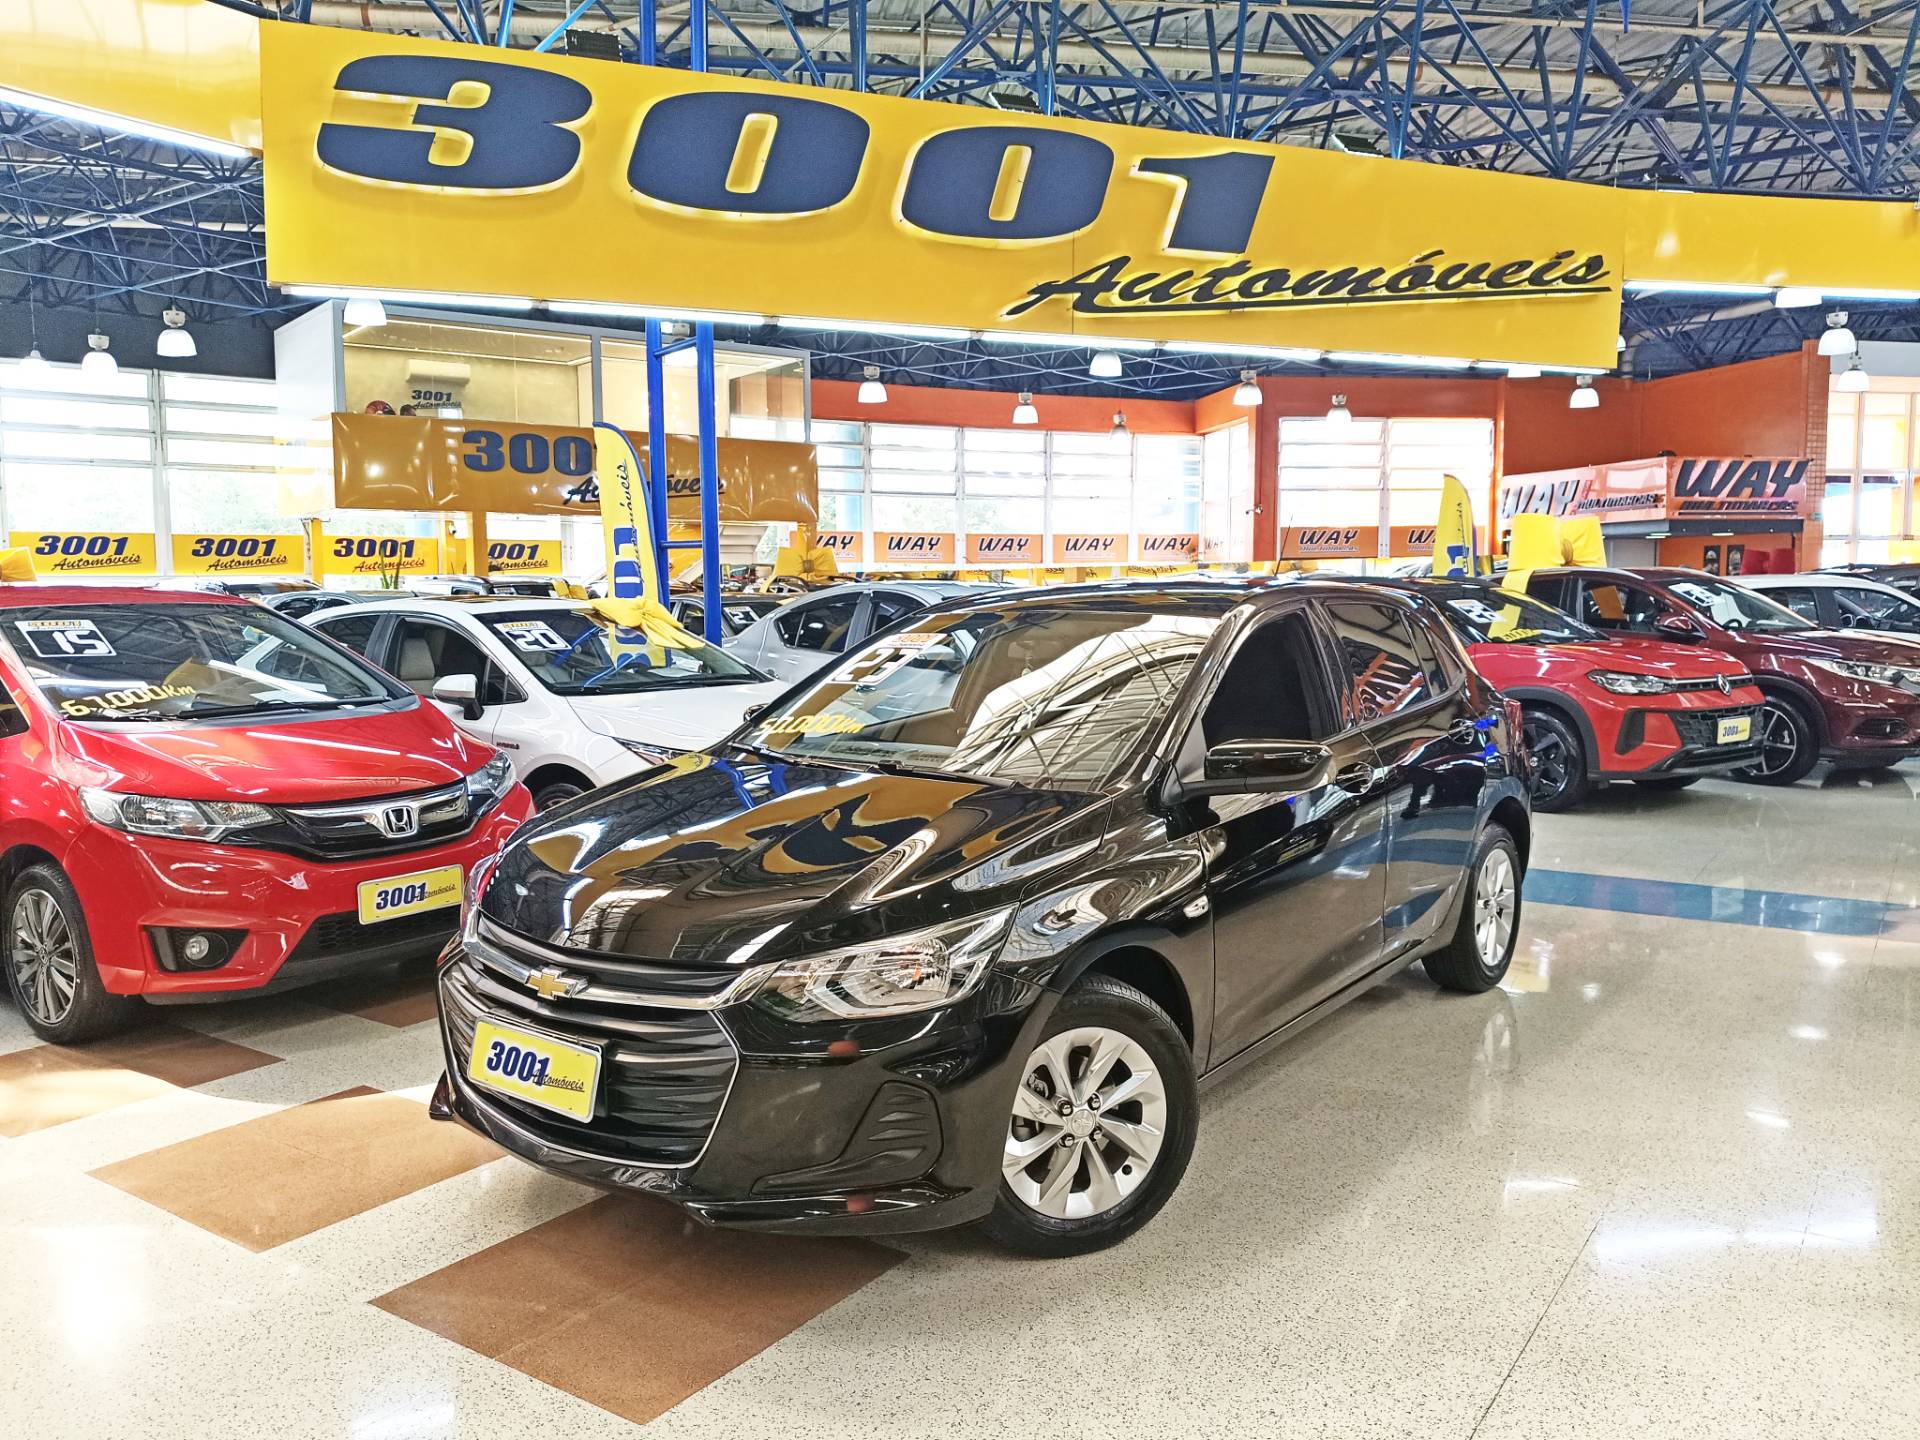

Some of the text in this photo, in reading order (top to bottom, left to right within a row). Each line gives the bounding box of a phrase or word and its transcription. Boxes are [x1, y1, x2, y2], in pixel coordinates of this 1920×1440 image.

[317, 55, 1275, 253] 3001
[1006, 249, 1612, 313] Automóveis
[411, 389, 452, 401] 3001
[463, 430, 598, 477] 300
[1675, 459, 1809, 497] WAY
[1502, 480, 1581, 518] WAY
[35, 535, 129, 556] 3001
[191, 537, 277, 557] 3001
[333, 537, 415, 558] 3001
[816, 535, 854, 549] AY
[888, 536, 941, 550] WAY
[979, 537, 1029, 551] WAY
[1065, 537, 1114, 551] WAY
[1143, 537, 1191, 551] WAY
[1299, 530, 1358, 545] WAY
[488, 542, 540, 560] 001
[51, 553, 143, 571] Automóveis
[206, 553, 289, 571] Automóveis
[51, 630, 110, 654] 15
[507, 629, 568, 651] 20
[376, 882, 427, 910] 3001
[486, 1040, 551, 1087] 3001
